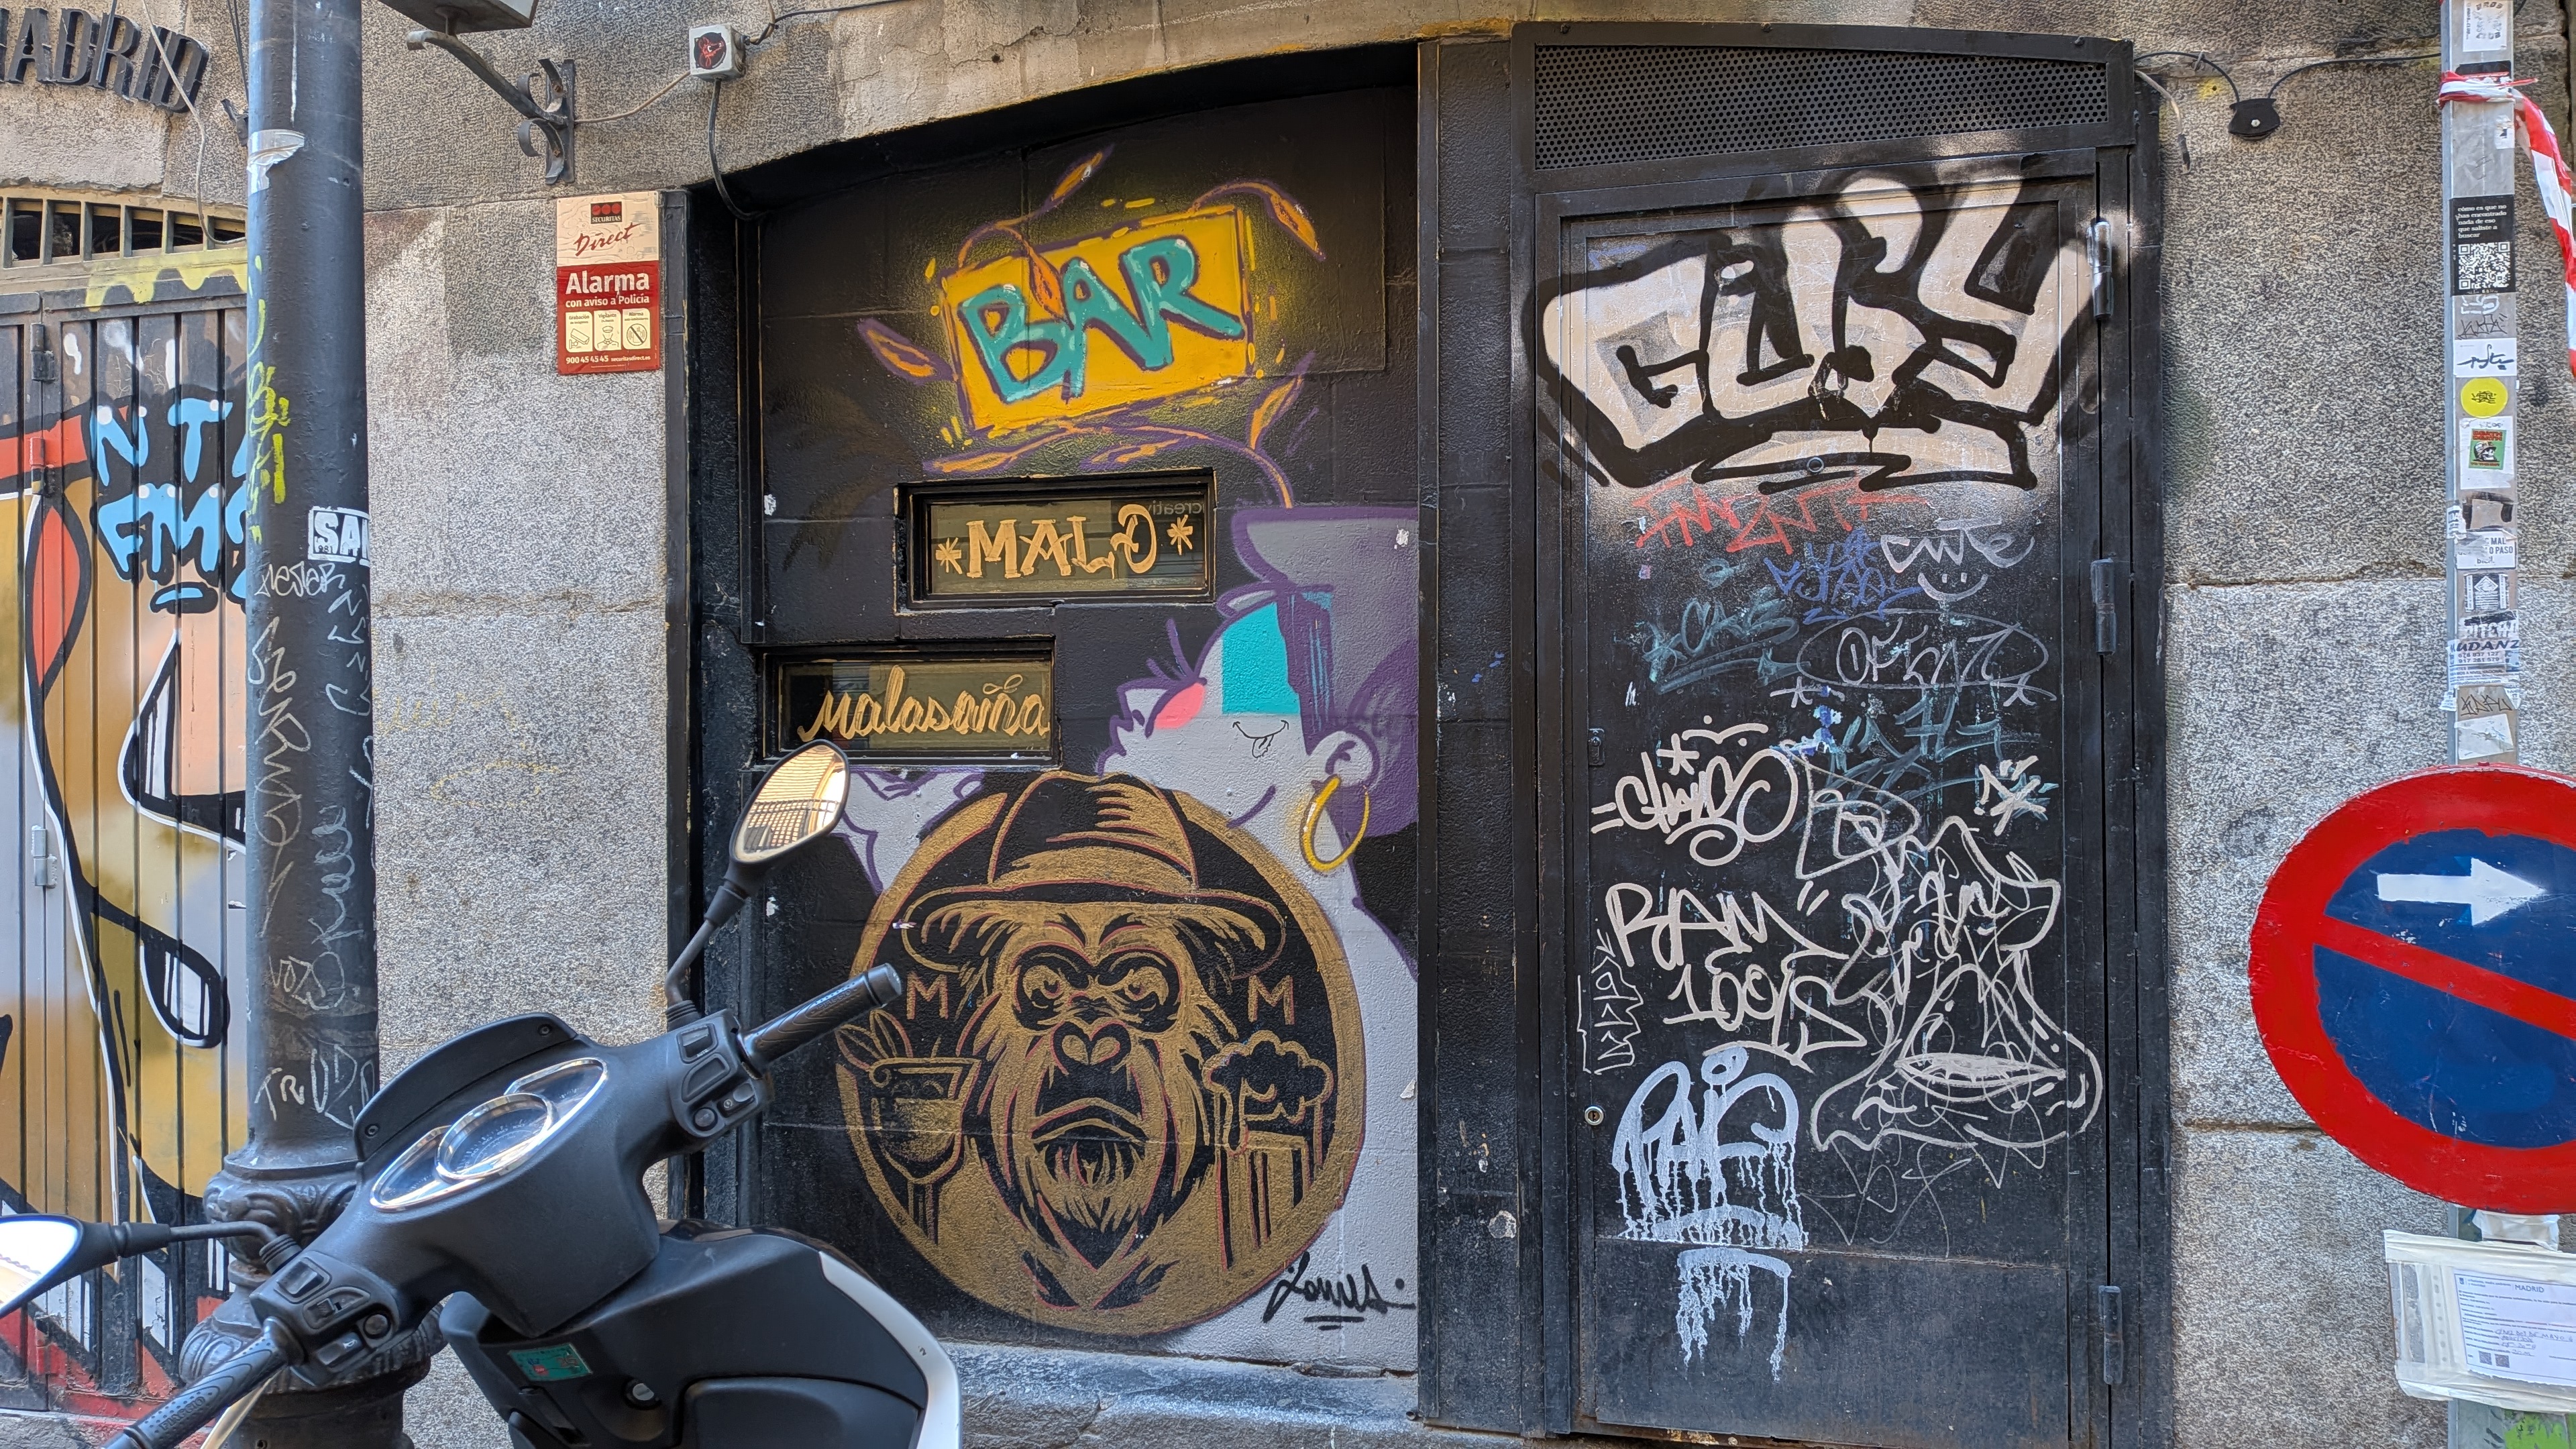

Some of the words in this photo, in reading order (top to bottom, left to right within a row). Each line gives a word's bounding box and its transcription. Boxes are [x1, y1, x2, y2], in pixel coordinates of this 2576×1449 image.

[0, 7, 209, 113] ADRID
[592, 215, 621, 223] SECURITAS
[2471, 210, 2508, 218] encontrado
[574, 222, 641, 257] Direct
[566, 270, 650, 294] Alarma
[566, 299, 583, 308] con
[584, 297, 608, 307] aviso
[610, 297, 616, 305] a
[618, 293, 650, 305] Policía
[958, 235, 1246, 404] BAR
[566, 356, 580, 364] 900
[966, 504, 1157, 580] MALO
[2490, 537, 2506, 545] MAL
[2495, 546, 2514, 555] PASO
[2514, 1284, 2544, 1293] MADRID
